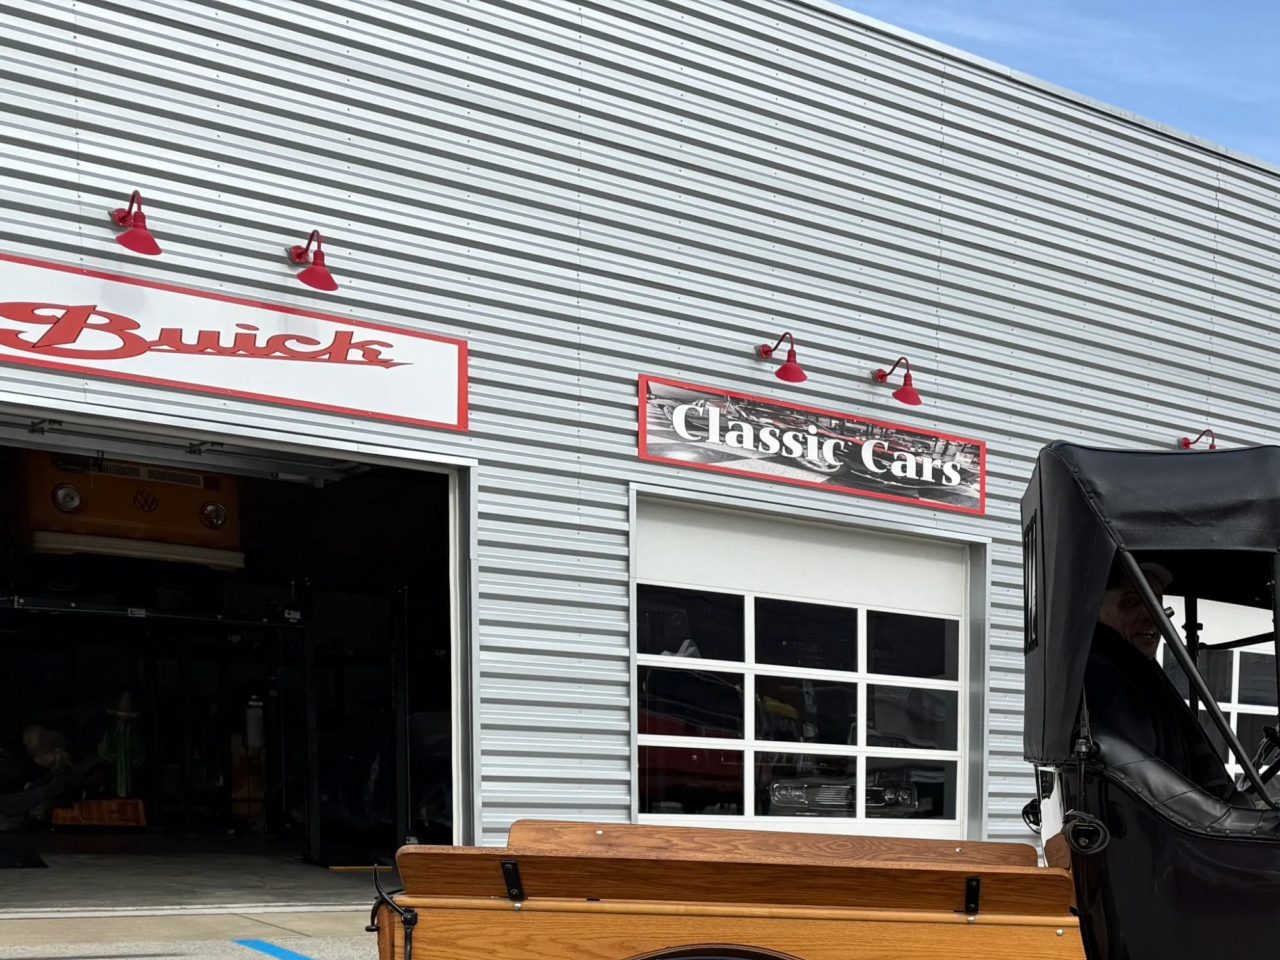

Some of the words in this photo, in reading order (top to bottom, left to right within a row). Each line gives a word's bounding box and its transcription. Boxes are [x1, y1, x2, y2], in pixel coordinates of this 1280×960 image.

[0, 302, 413, 368] Buick
[671, 402, 845, 467] Classic
[861, 439, 961, 486] Cars
